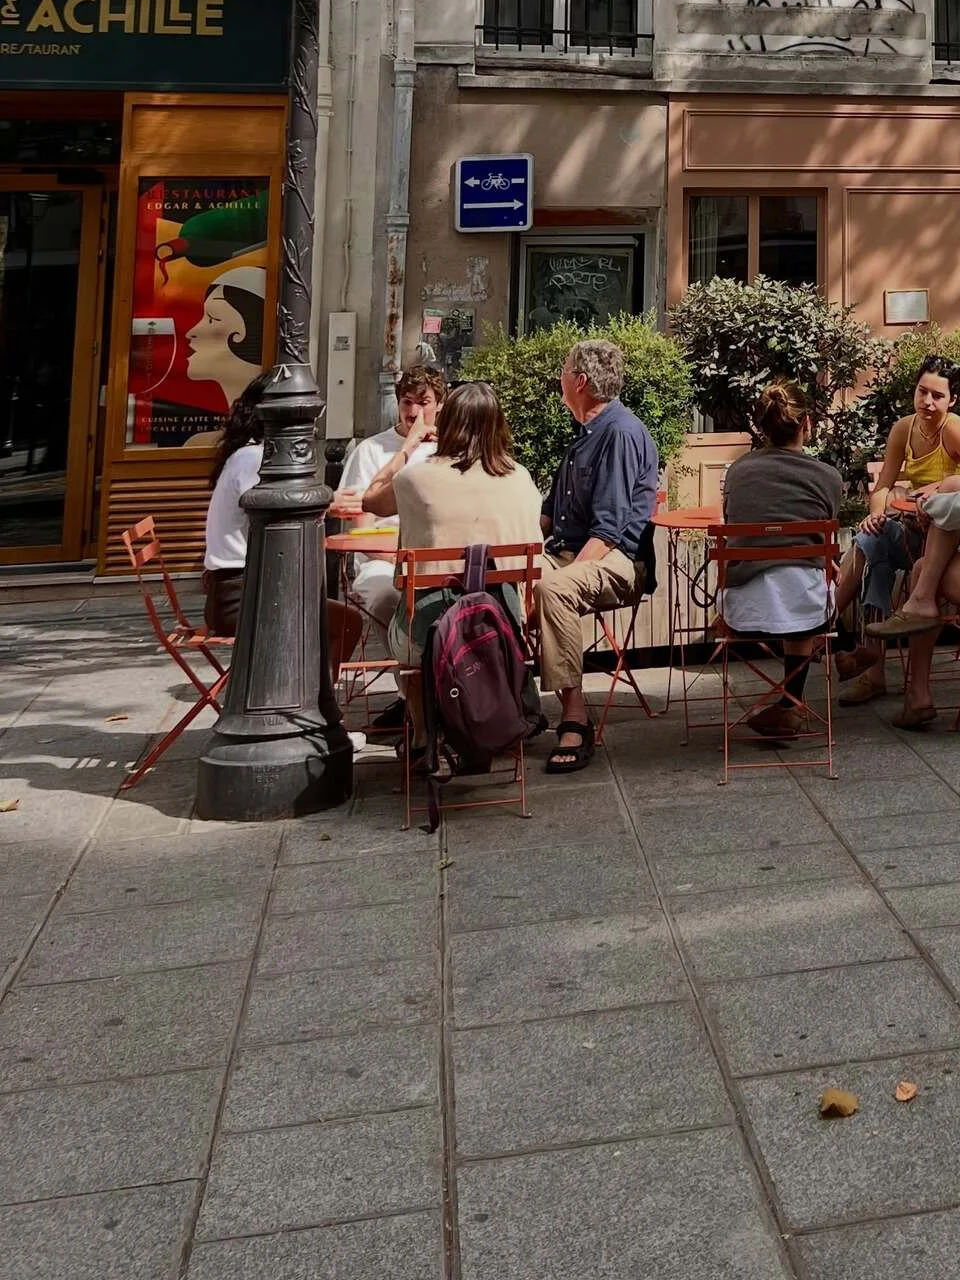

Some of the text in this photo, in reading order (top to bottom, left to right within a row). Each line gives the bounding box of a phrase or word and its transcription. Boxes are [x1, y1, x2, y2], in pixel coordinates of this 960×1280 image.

[1, 43, 81, 55] RESTAURANT
[145, 188, 261, 199] ESTAURANT
[147, 201, 261, 210] EDGAR & ACHILLE
